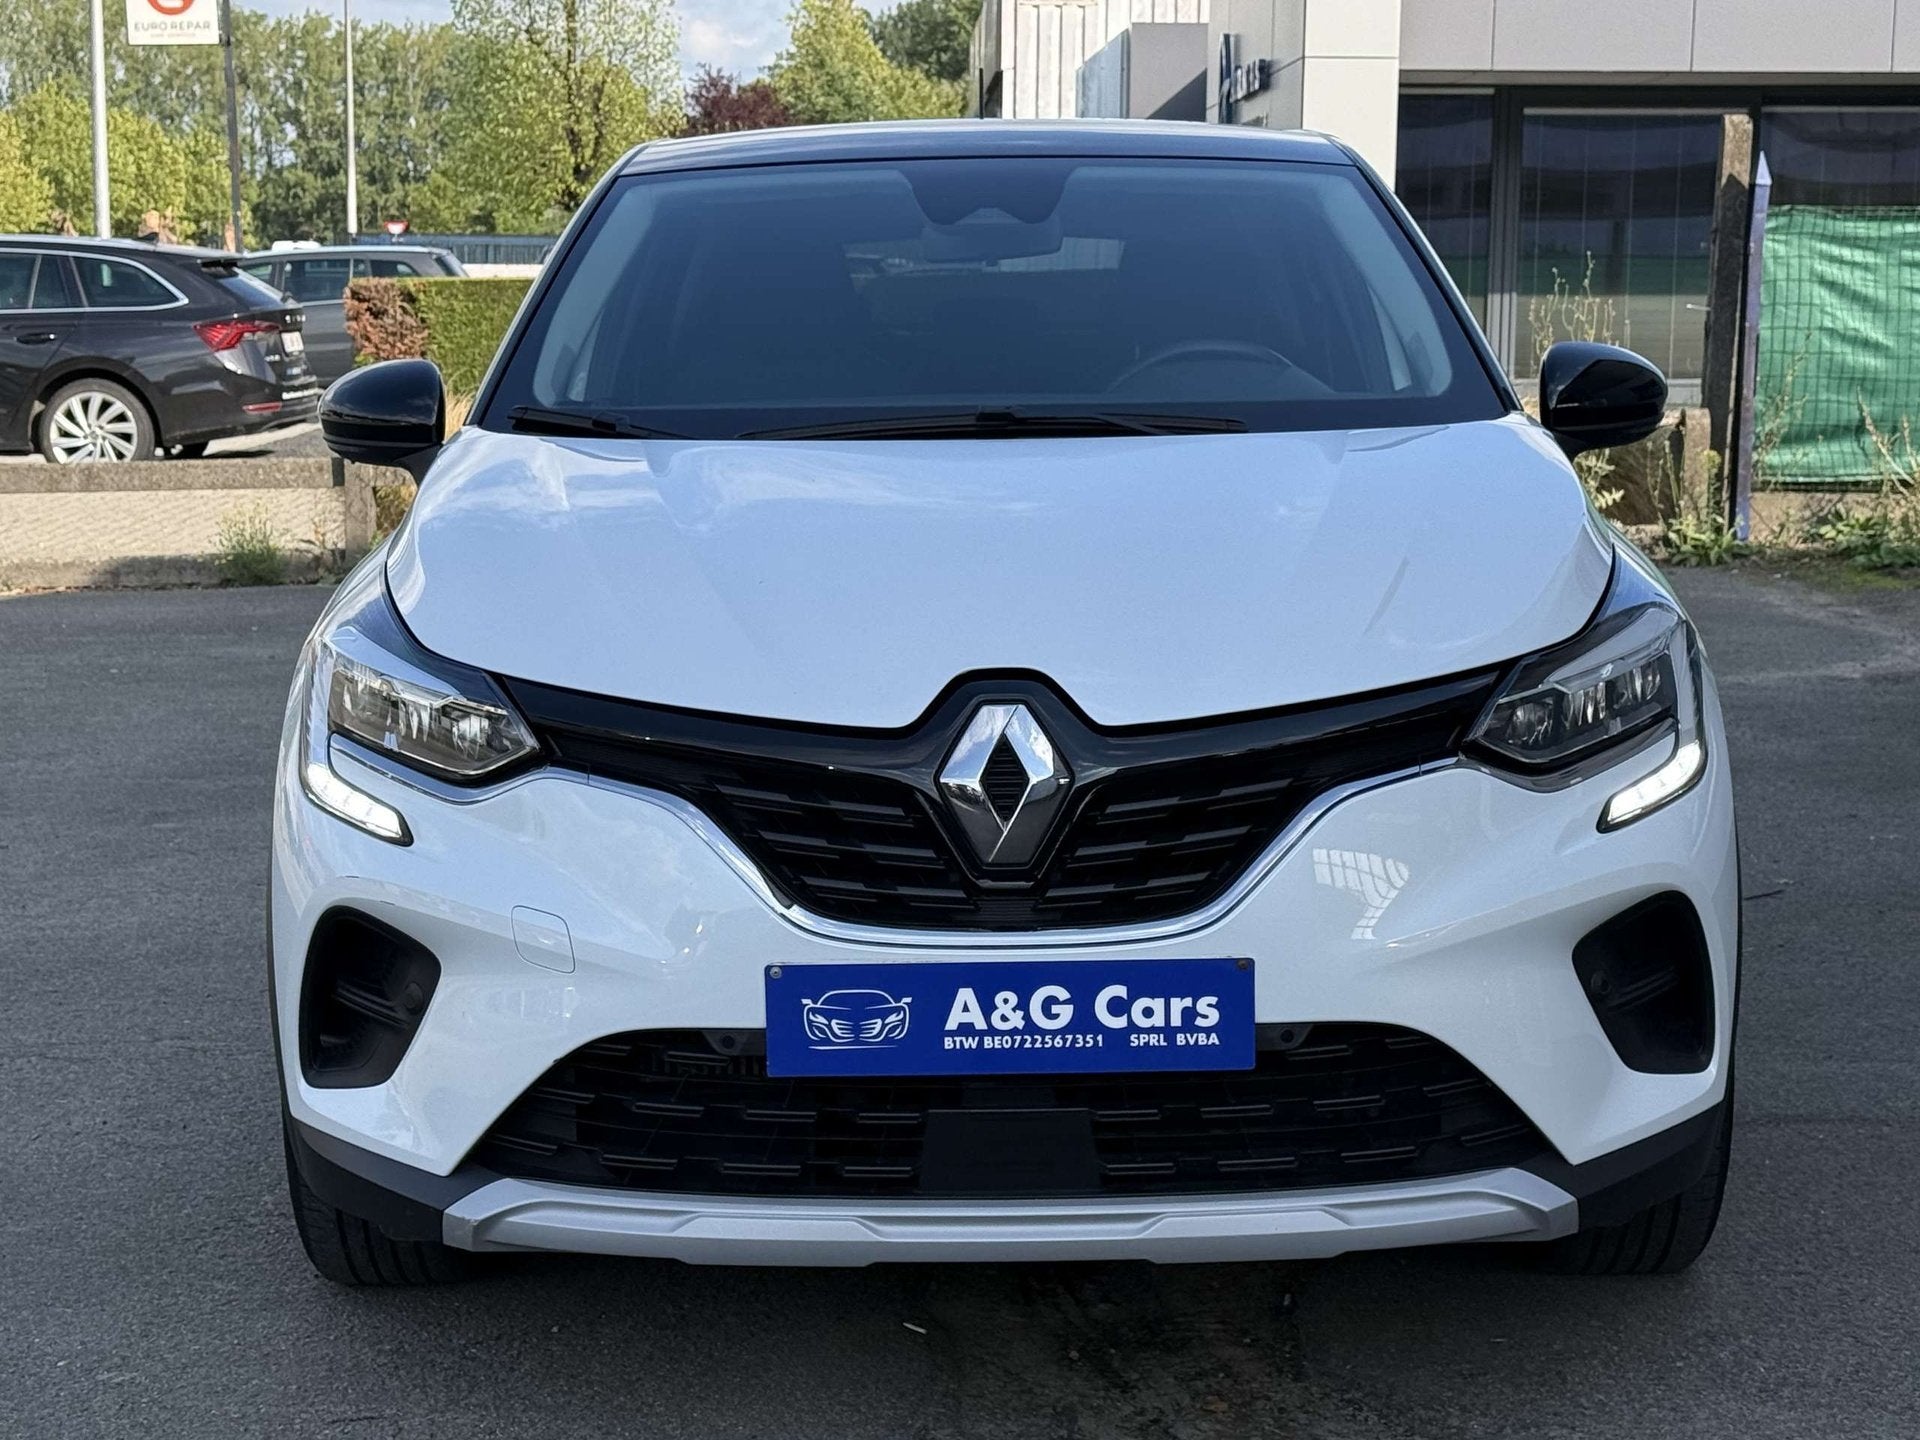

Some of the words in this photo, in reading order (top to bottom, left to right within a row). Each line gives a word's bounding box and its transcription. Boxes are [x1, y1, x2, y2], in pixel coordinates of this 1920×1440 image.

[944, 985, 1074, 1031] A&G
[1094, 984, 1220, 1029] Cars
[944, 1036, 979, 1049] BTW
[983, 1034, 1103, 1049] BE0722567351
[1130, 1033, 1167, 1047] SPRL
[1176, 1032, 1220, 1046] BVBA
